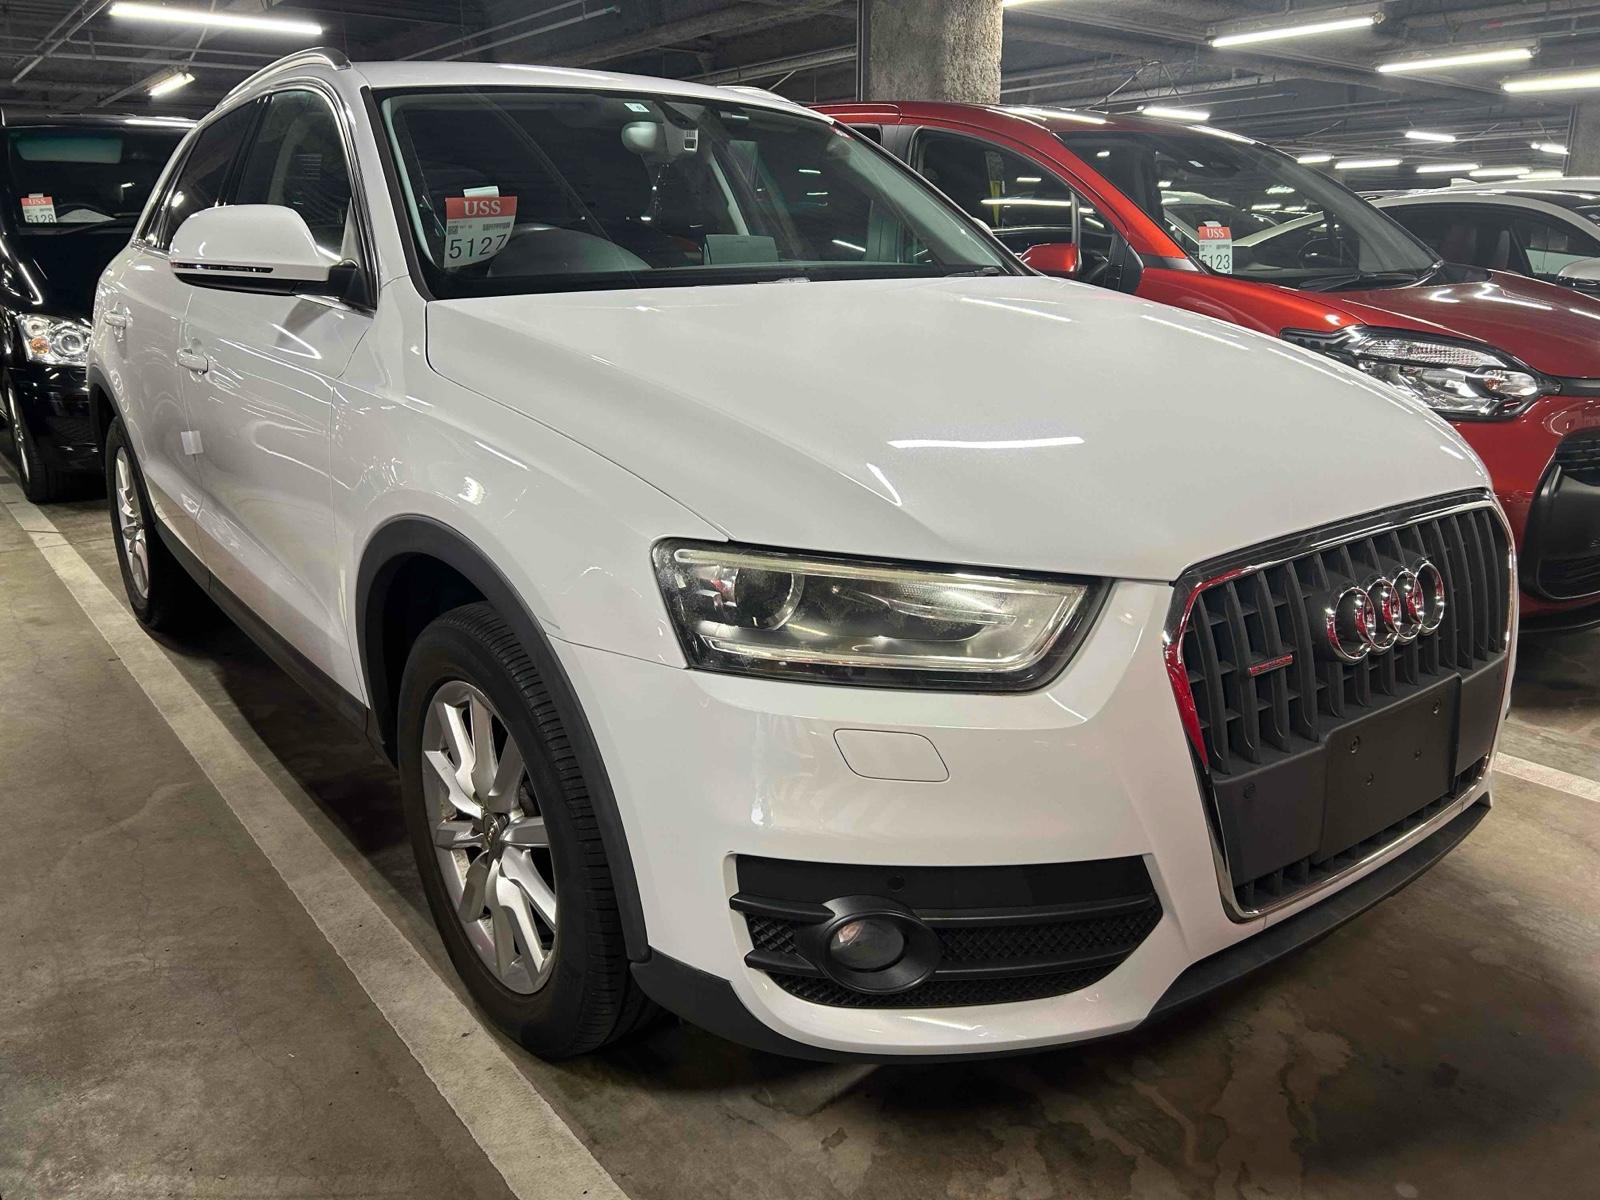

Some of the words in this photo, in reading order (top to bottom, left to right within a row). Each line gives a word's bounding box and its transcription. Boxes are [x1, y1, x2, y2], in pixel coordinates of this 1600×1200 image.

[464, 200, 501, 216] USS
[1207, 228, 1225, 239] USS
[448, 234, 507, 259] 5127
